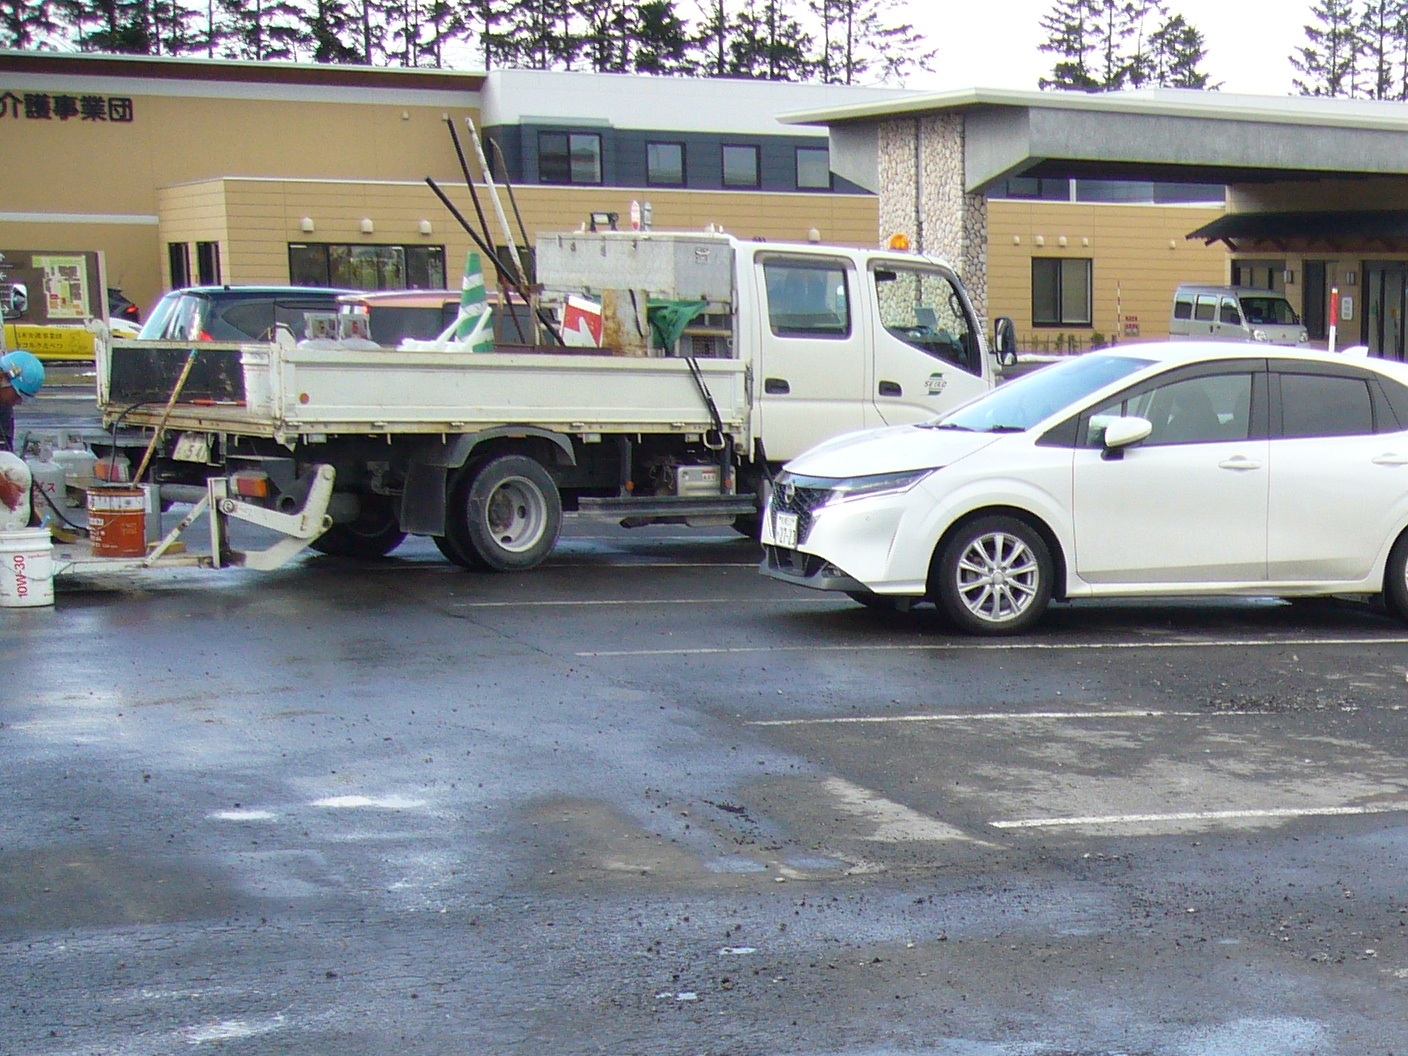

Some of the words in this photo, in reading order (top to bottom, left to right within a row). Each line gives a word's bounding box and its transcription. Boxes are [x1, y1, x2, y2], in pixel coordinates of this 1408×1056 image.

[0, 92, 134, 123] 介護事業団
[13, 554, 28, 600] 10W-30
